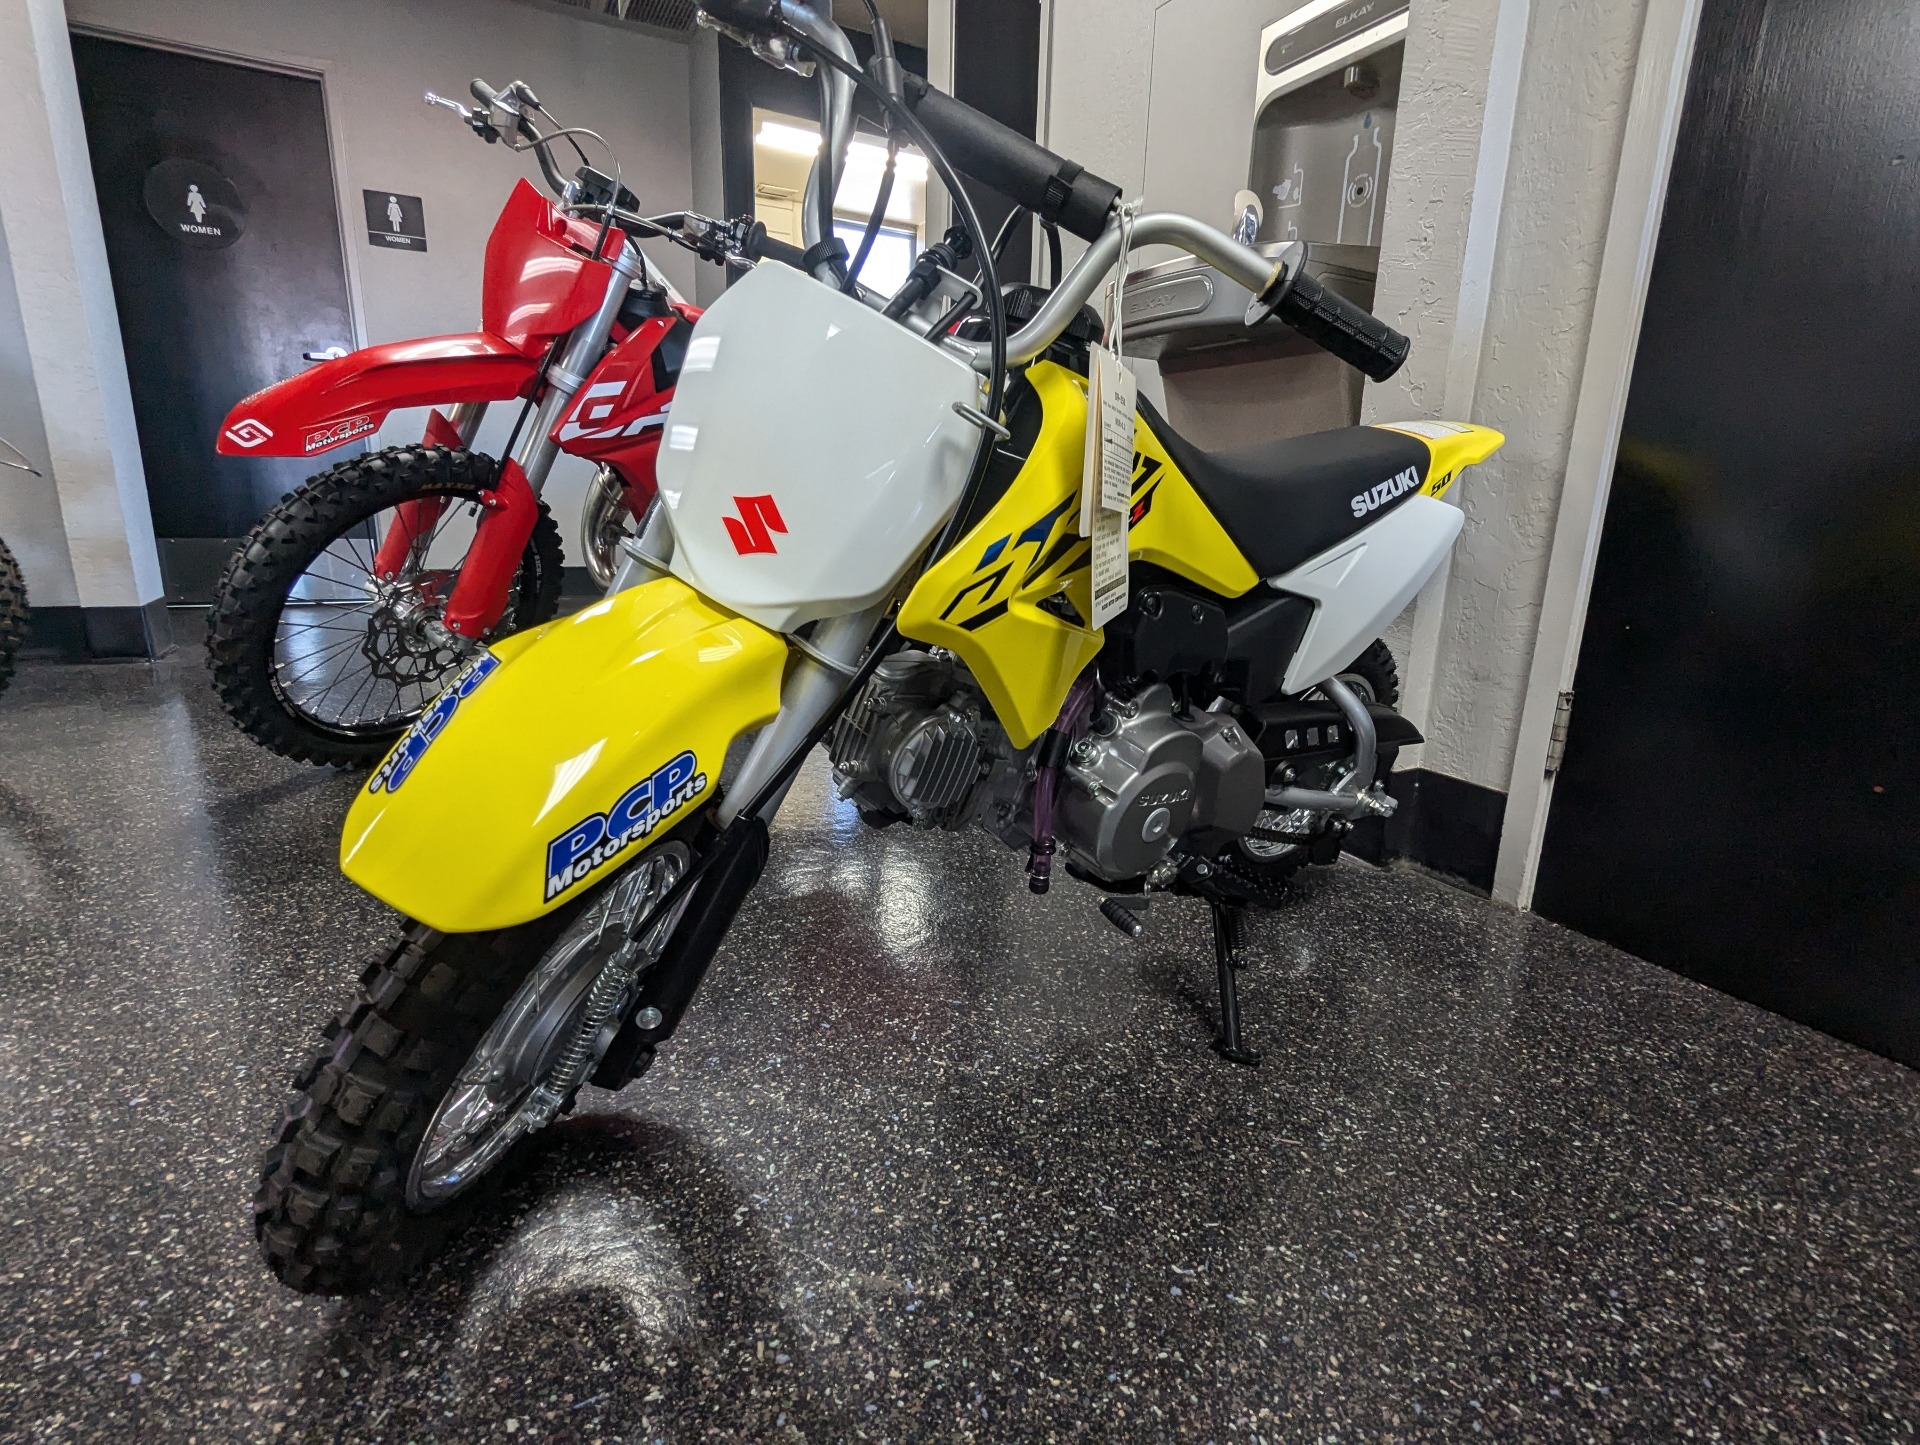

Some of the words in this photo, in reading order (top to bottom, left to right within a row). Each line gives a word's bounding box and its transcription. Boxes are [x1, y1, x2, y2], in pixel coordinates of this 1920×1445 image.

[1335, 2, 1375, 29] ELKAY
[180, 223, 221, 236] WOMEN
[385, 235, 411, 244] WOMEN
[1129, 293, 1176, 314] ELKAY
[305, 423, 375, 452] Motorsports
[306, 415, 370, 444] PCP
[1350, 465, 1420, 519] SUZUKI
[1431, 469, 1452, 497] 50
[370, 651, 491, 792] Motorsports
[387, 655, 499, 792] PCP
[1139, 789, 1190, 807] SUZUKI
[548, 752, 696, 880] PCP
[547, 774, 706, 899] Motorsports
